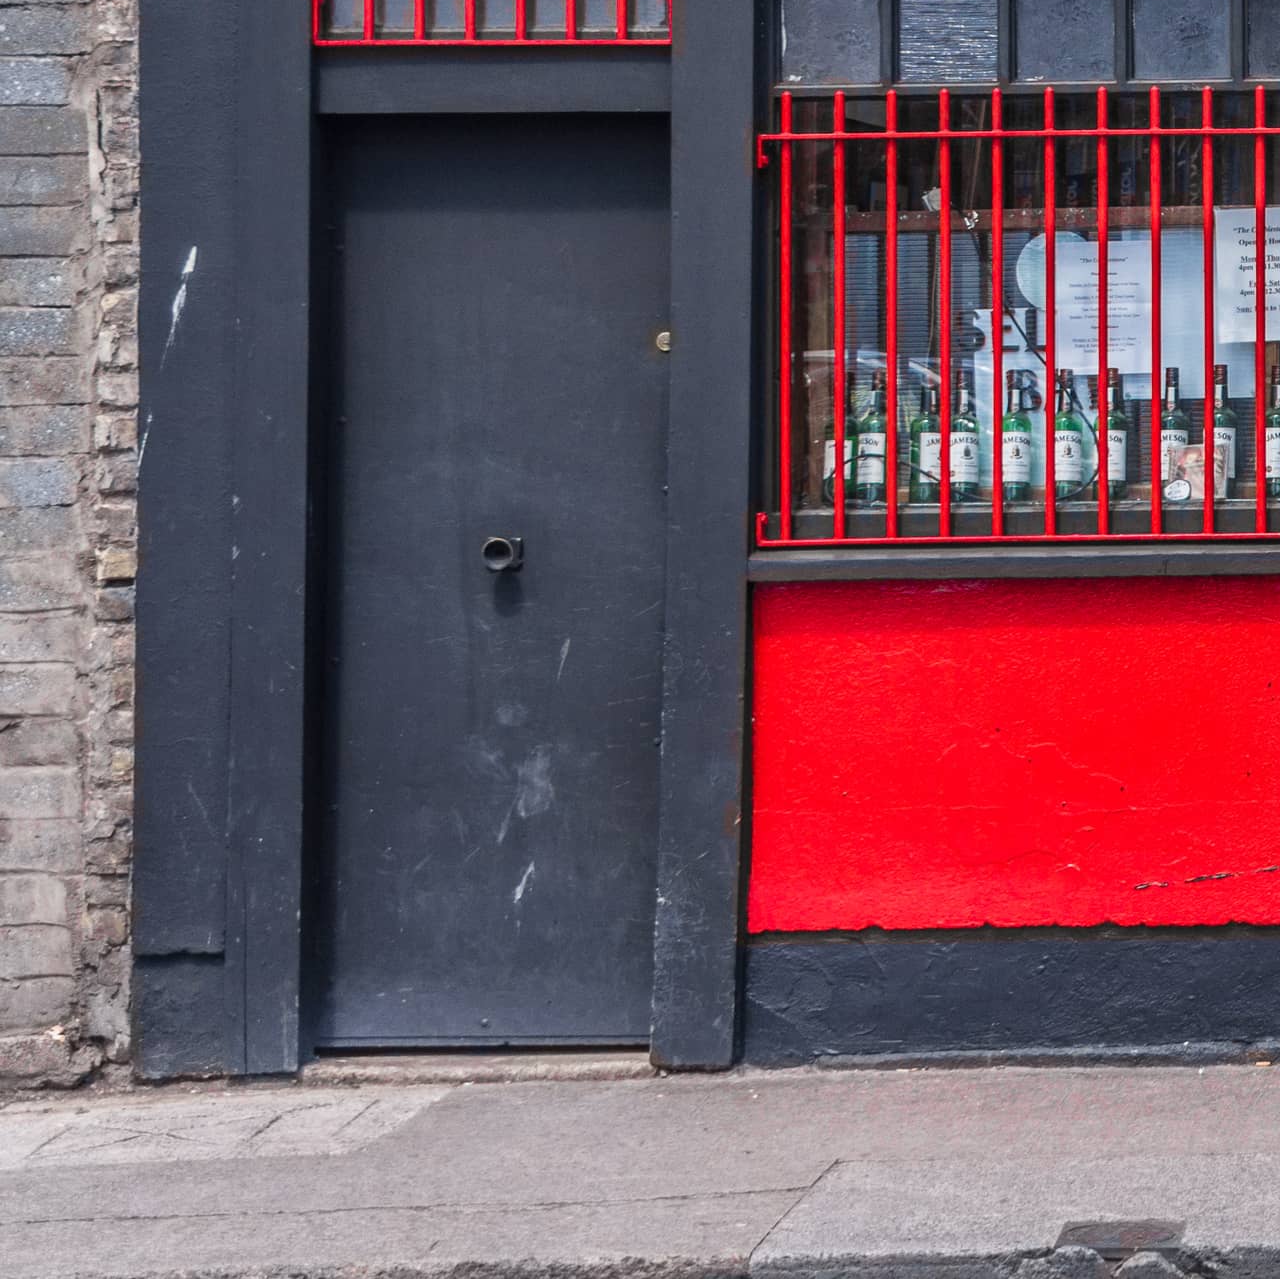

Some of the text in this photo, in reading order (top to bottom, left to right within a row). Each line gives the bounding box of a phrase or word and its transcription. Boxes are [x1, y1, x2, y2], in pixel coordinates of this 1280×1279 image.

[1002, 436, 1030, 445] AMESON
[1055, 435, 1081, 444] AMESON
[1161, 434, 1187, 443] MESON
